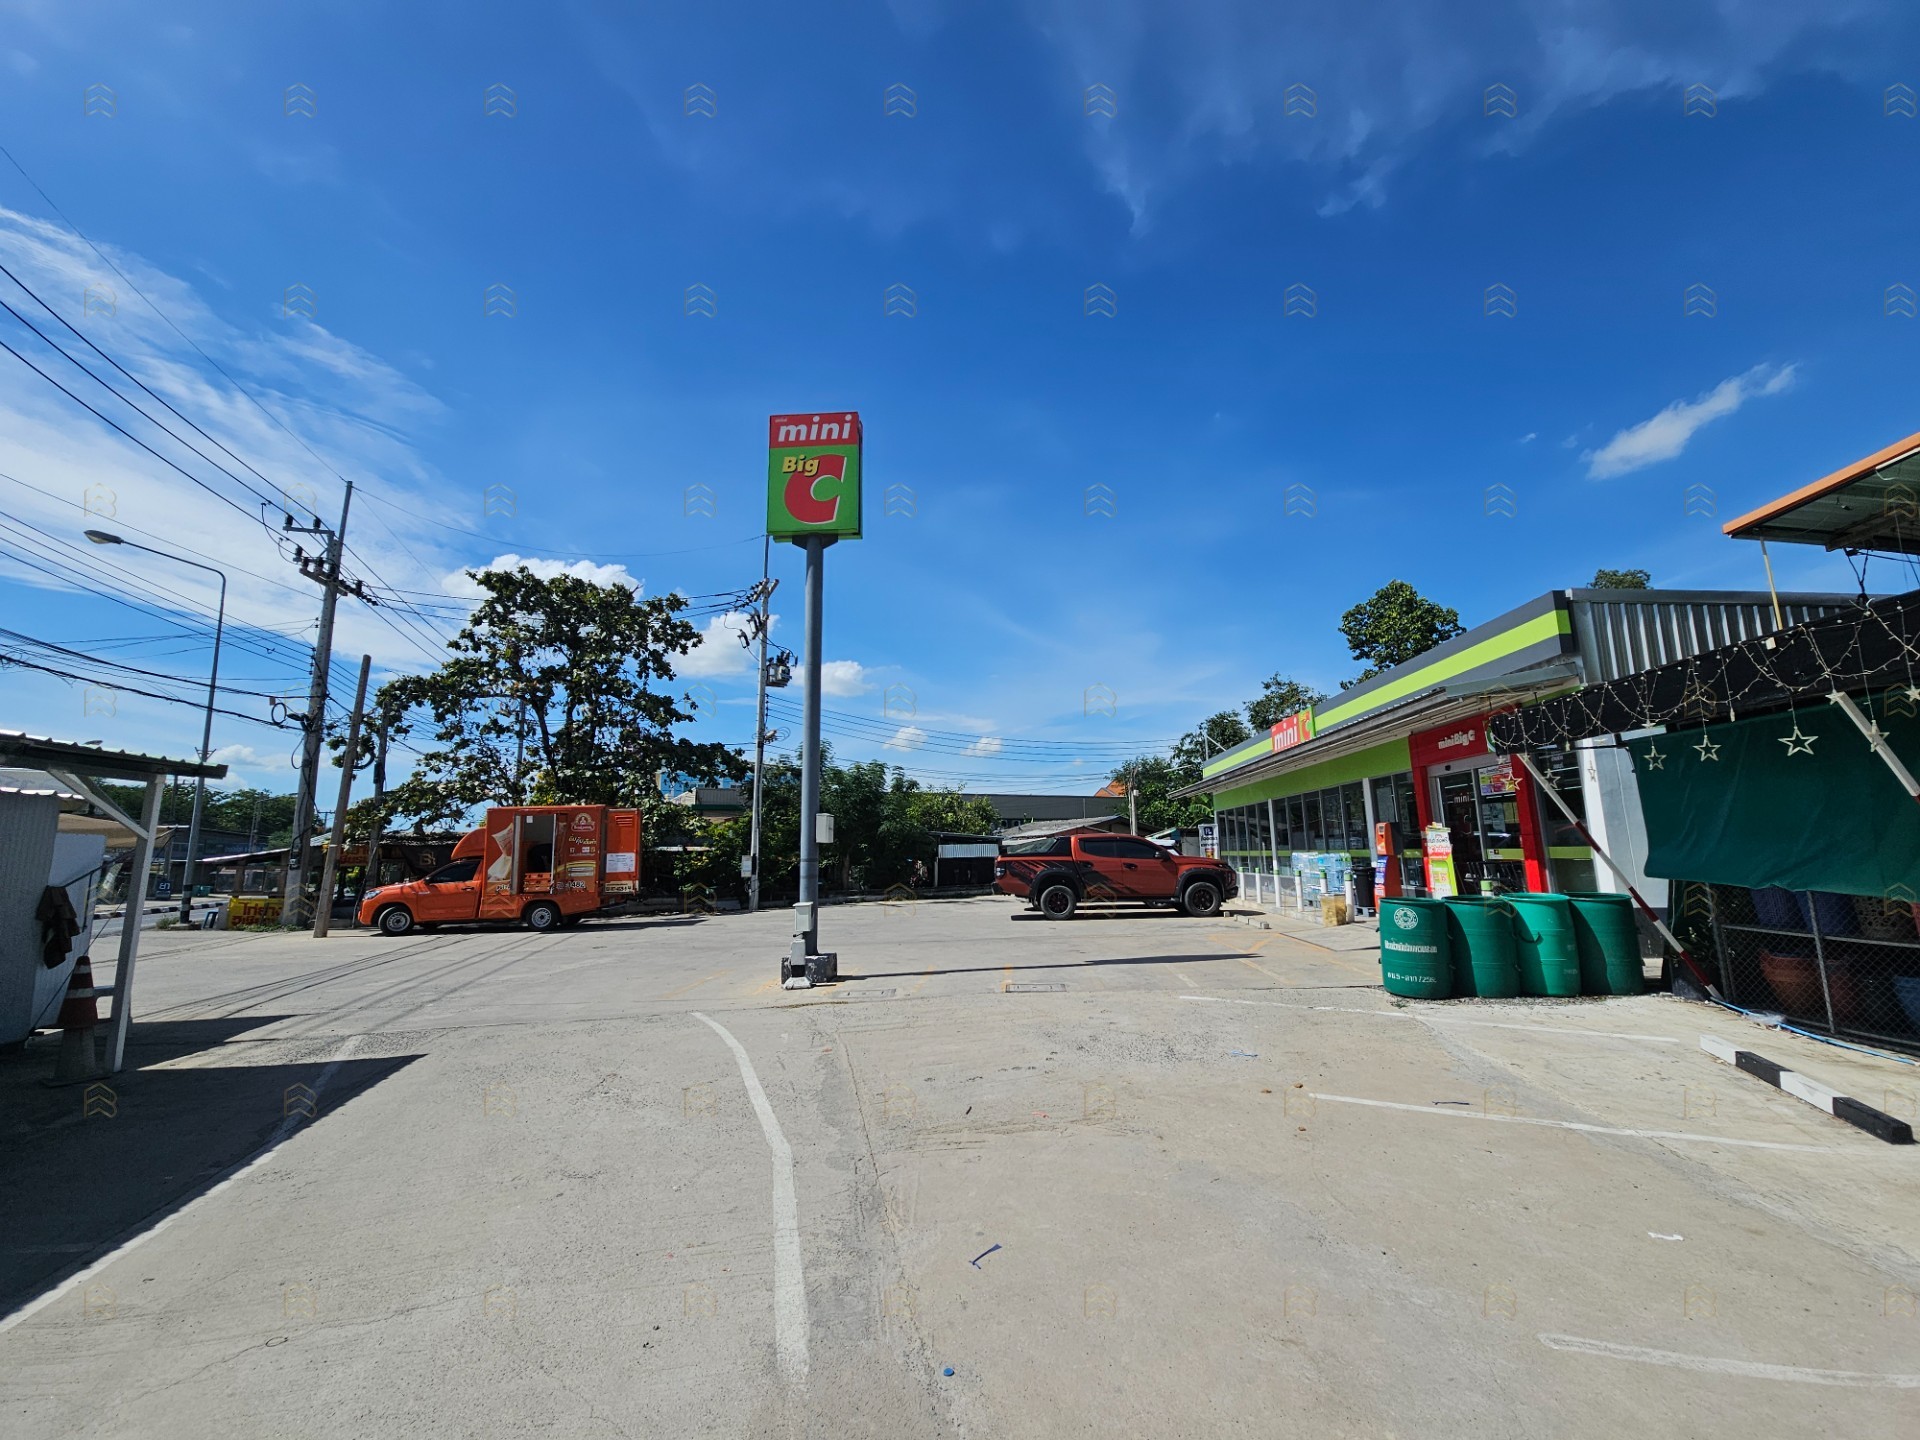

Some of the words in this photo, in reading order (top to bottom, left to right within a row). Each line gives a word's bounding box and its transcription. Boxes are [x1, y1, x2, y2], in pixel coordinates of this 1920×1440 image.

[778, 414, 852, 442] mini
[782, 455, 820, 477] Big
[784, 454, 847, 525] C
[1274, 716, 1298, 751] mini
[1453, 792, 1470, 804] mini
